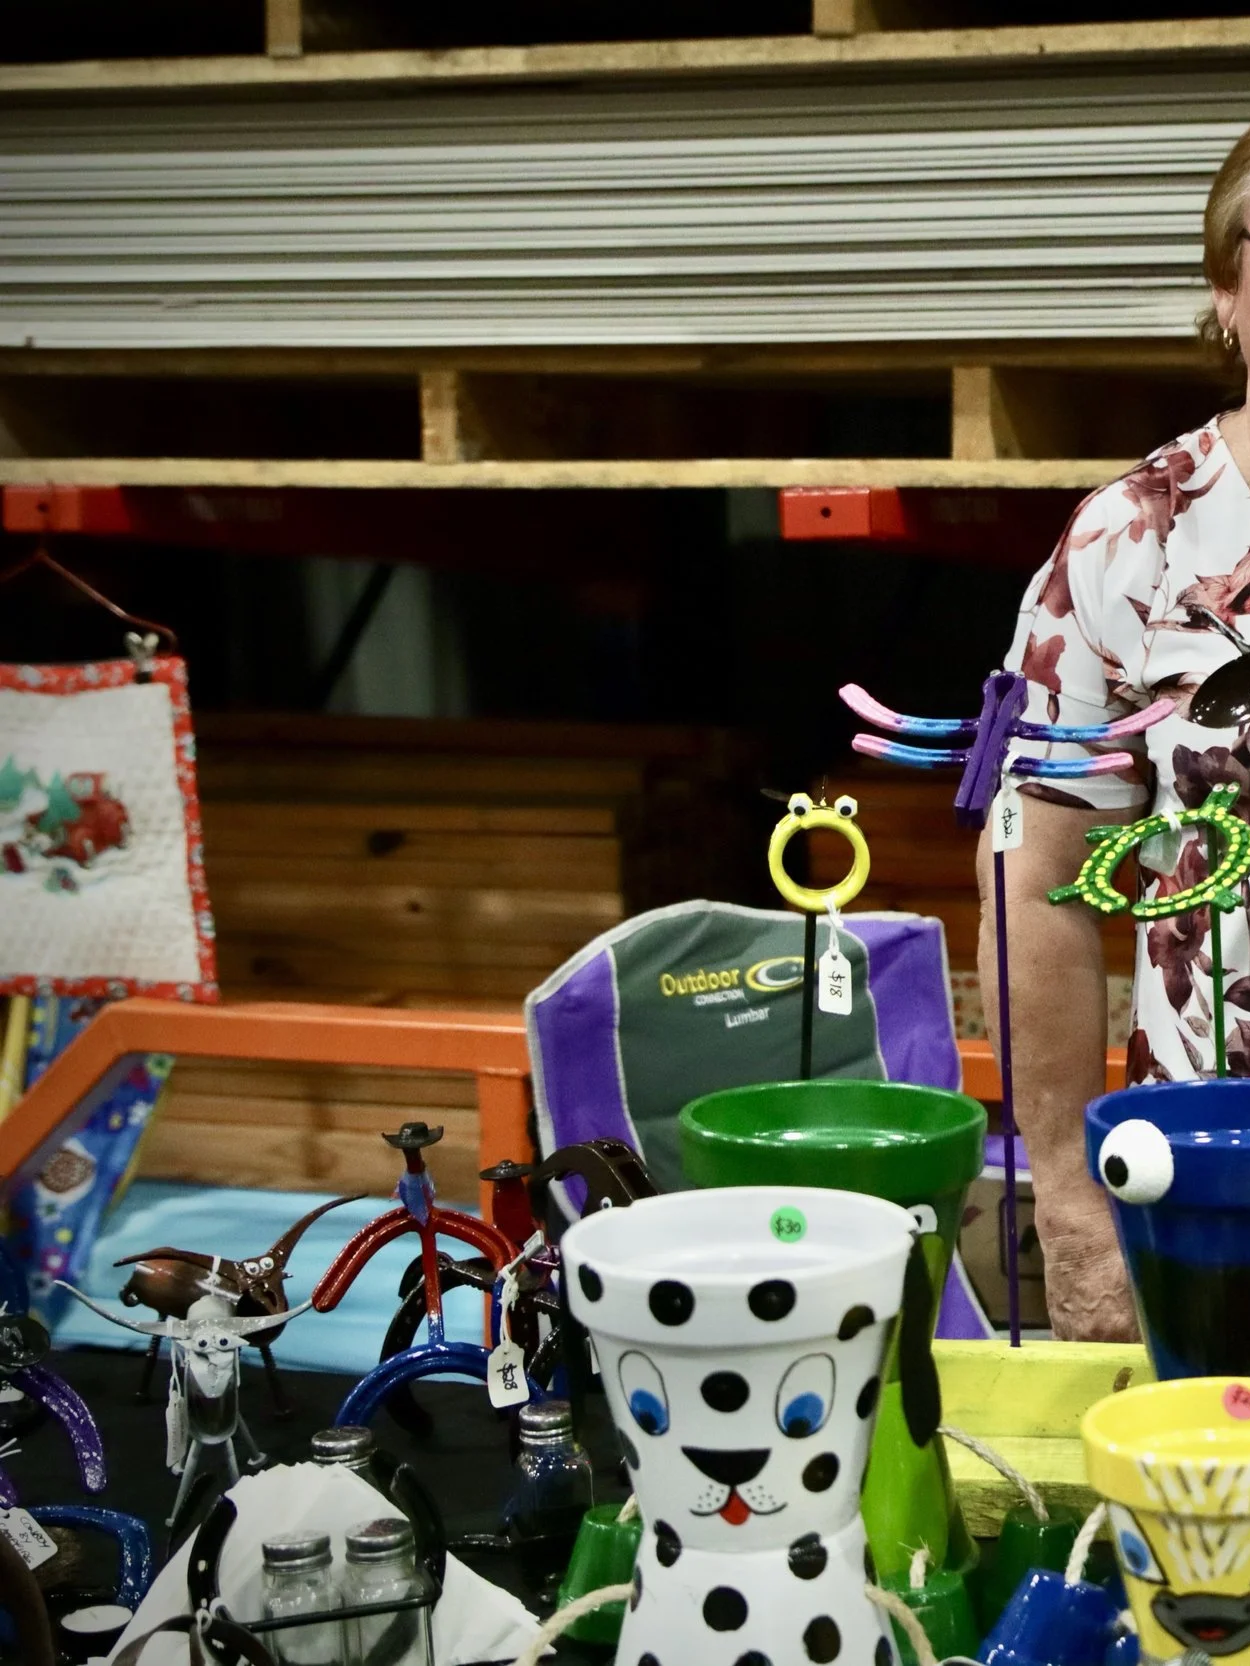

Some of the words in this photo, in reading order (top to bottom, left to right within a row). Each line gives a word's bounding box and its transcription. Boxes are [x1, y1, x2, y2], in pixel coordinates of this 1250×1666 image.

[661, 968, 740, 996] Outdoor
[828, 970, 846, 998] $18
[724, 1007, 770, 1028] Lumbar
[775, 1215, 802, 1237] $30
